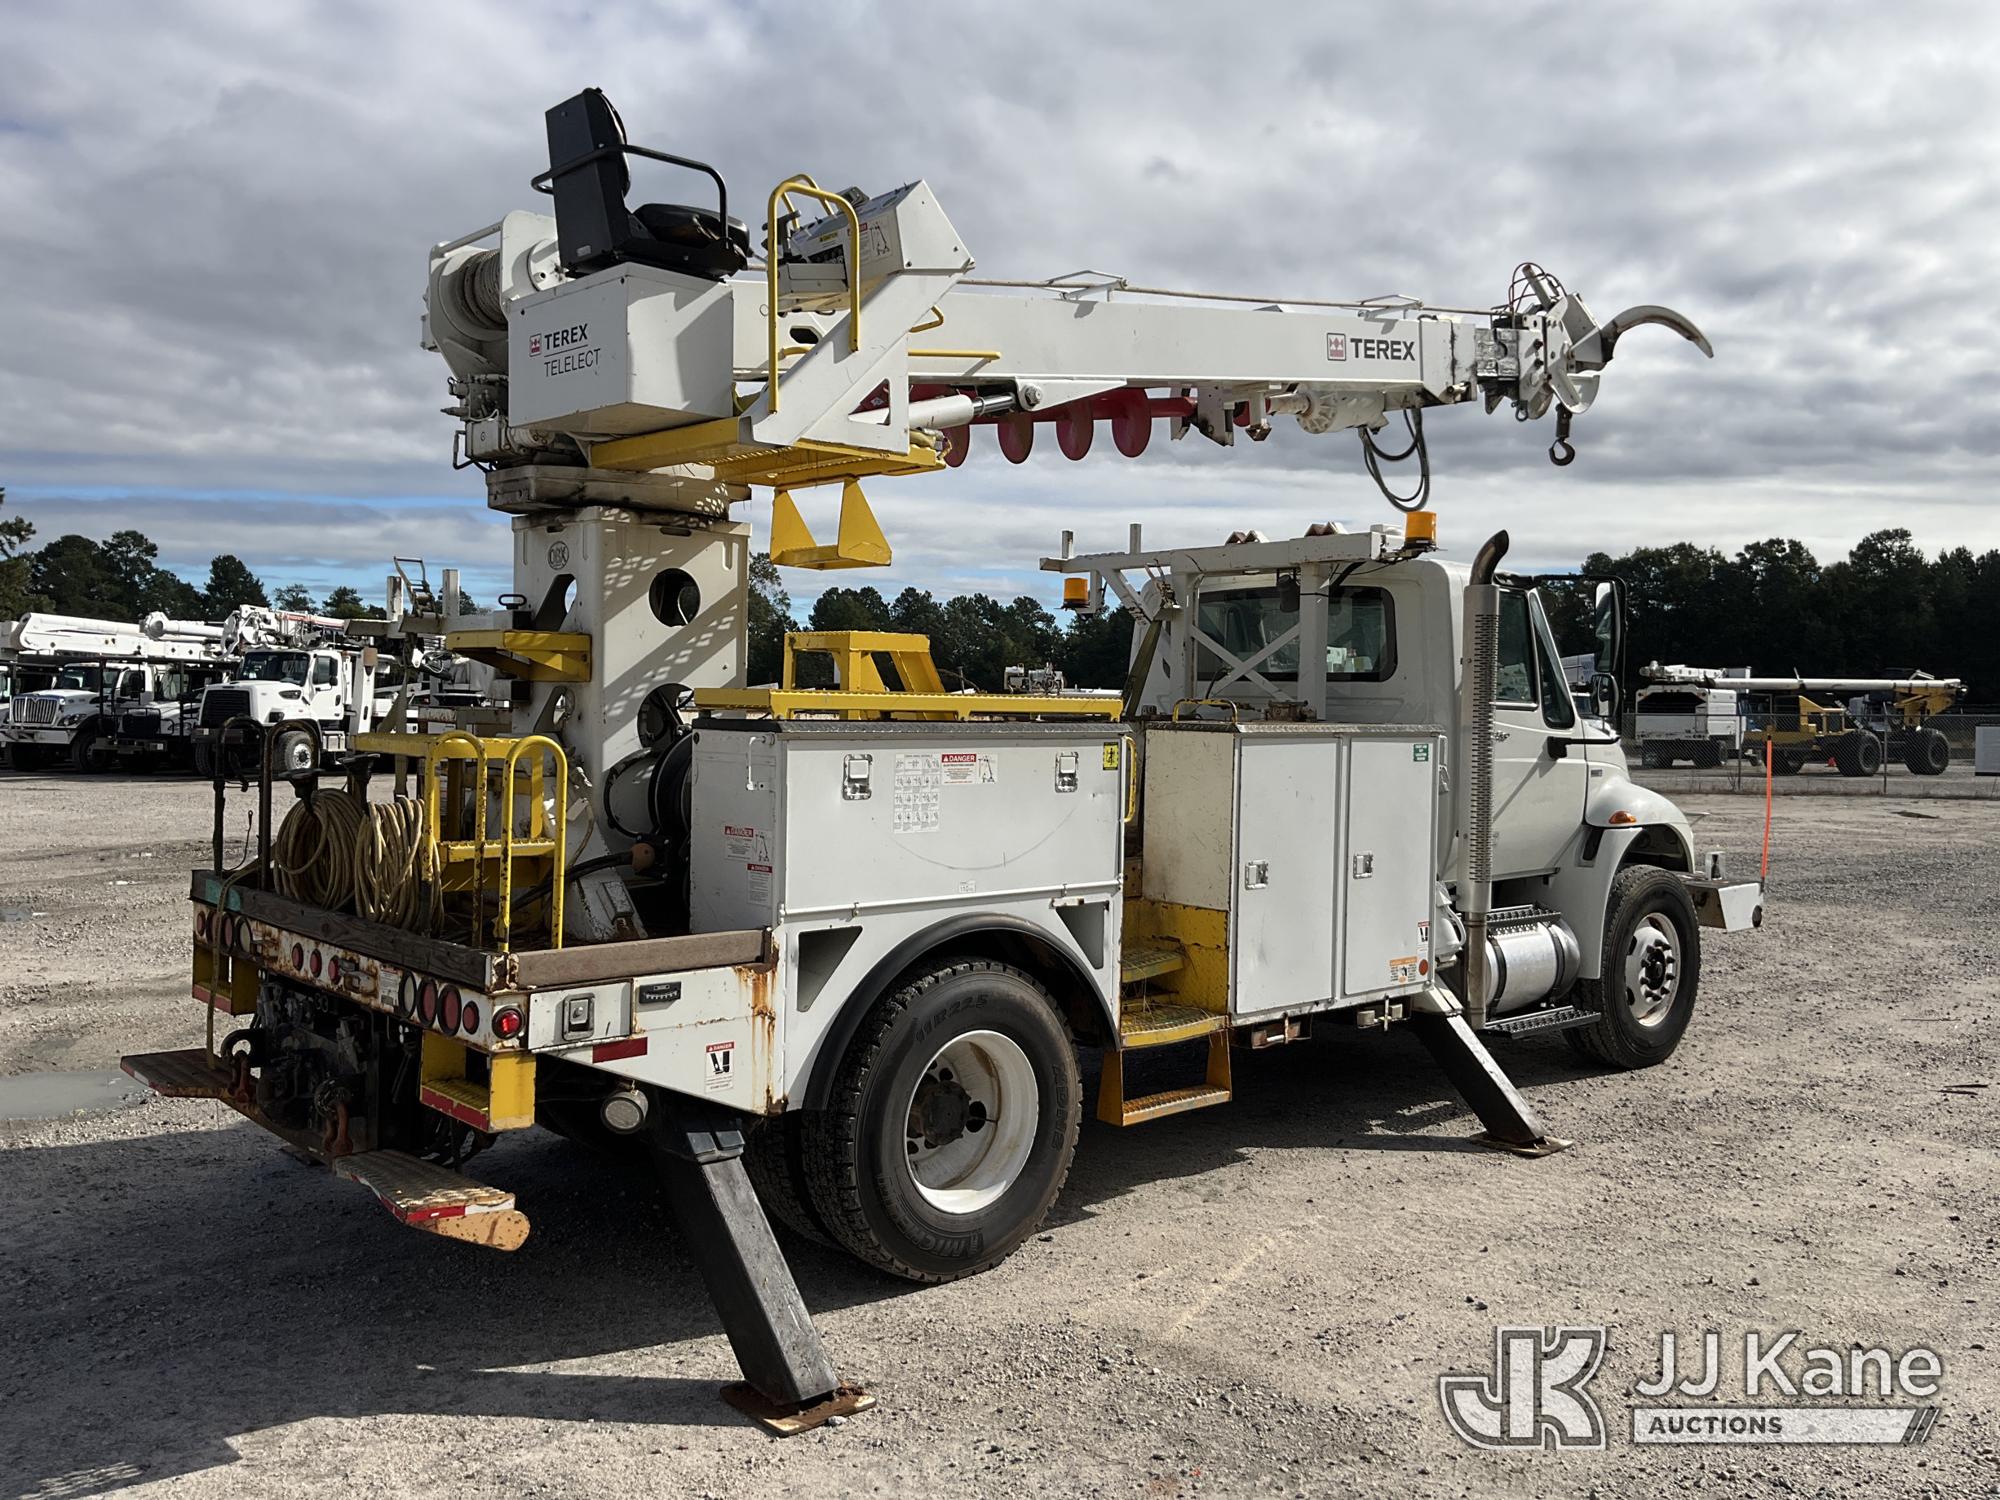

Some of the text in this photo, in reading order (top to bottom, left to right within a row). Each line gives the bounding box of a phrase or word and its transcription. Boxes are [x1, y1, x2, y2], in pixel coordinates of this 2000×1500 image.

[544, 323, 588, 350] TEREX
[1350, 337, 1416, 361] TEREX
[544, 347, 601, 377] TELELECT
[948, 754, 975, 762] DANGER
